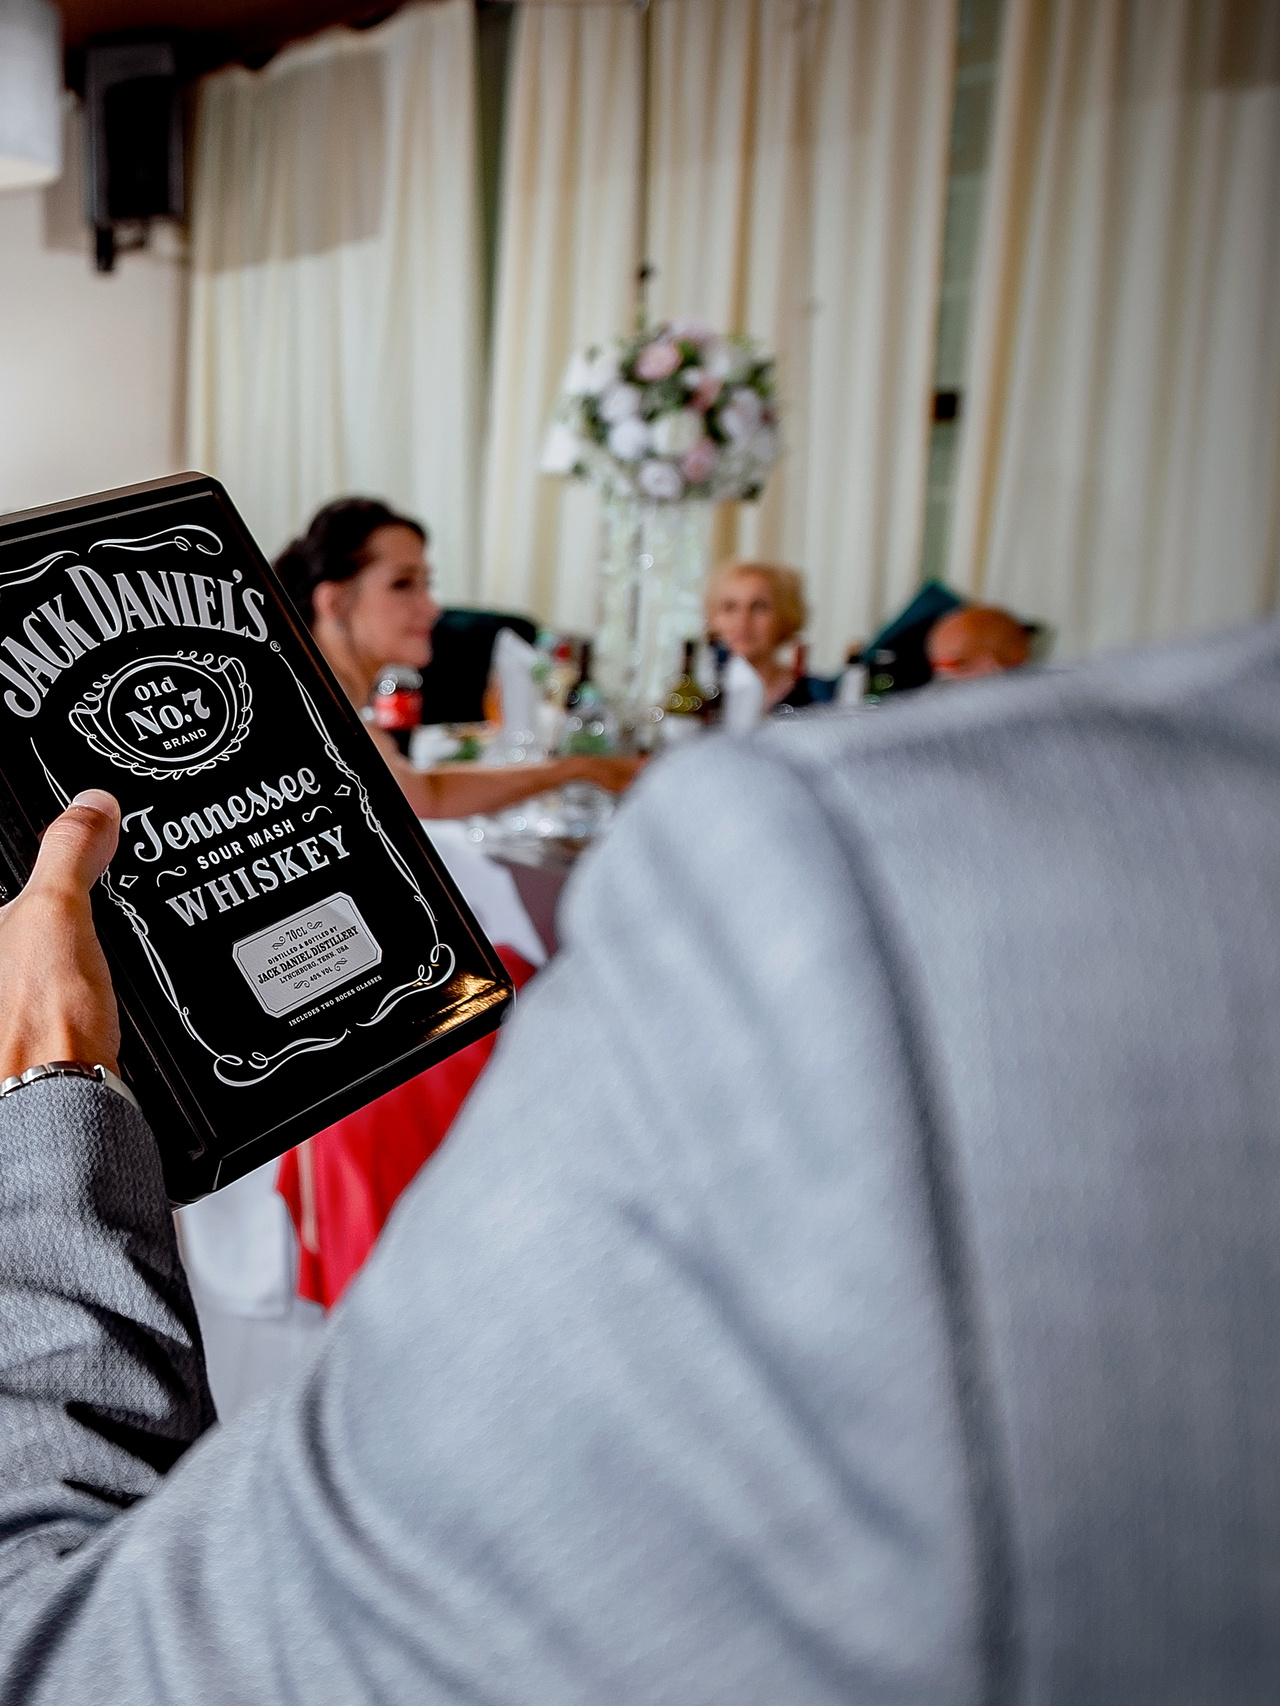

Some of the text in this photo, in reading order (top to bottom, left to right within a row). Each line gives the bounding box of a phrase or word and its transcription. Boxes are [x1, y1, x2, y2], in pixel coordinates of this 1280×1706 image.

[64, 565, 269, 642] DANIEL'S
[134, 676, 178, 701] Old
[162, 728, 207, 750] BRAND
[121, 767, 321, 862] Tennessee
[196, 818, 296, 870] SOUR MASH
[165, 825, 351, 927] WHISKEY
[257, 925, 359, 984] JACK DANIEL DISTILLERY
[267, 946, 298, 965] DISTILLED
[303, 930, 330, 947] BOTTLED
[329, 925, 338, 934] BY
[320, 966, 333, 976] VOL
[335, 944, 350, 954] USA
[288, 974, 383, 1027] INCLUDES TWO ROCKS GLASSES
